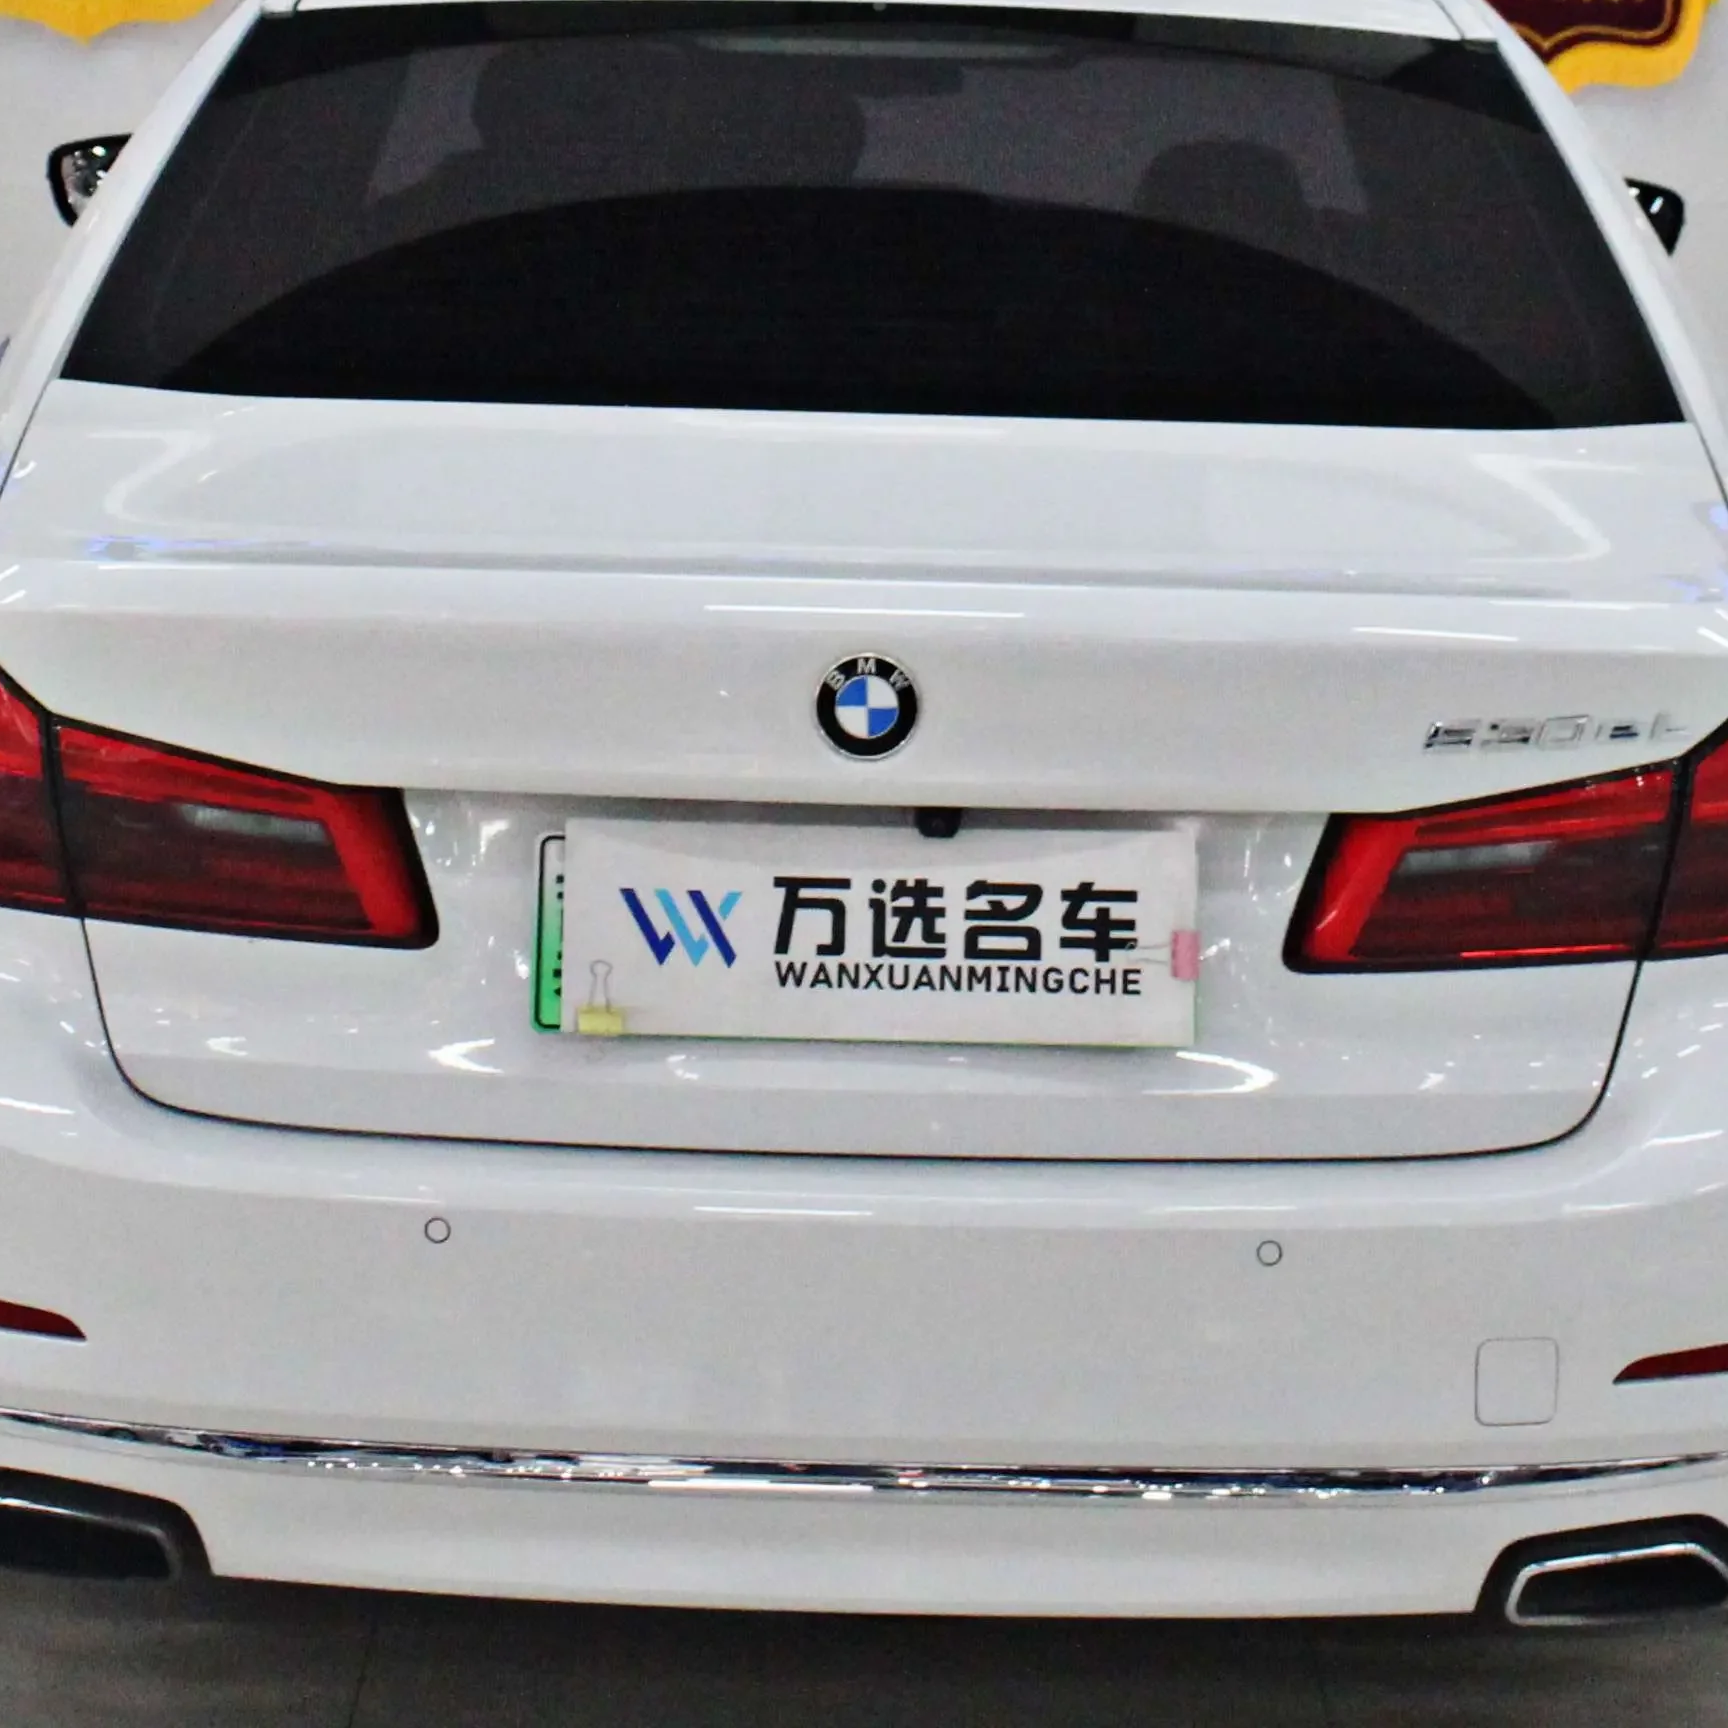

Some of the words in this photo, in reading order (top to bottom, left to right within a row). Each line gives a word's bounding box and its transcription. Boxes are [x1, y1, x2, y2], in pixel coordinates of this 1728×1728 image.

[825, 658, 911, 692] BMW
[773, 876, 1138, 962] 万选名车
[775, 962, 1141, 996] WANXUANMINGCHE
